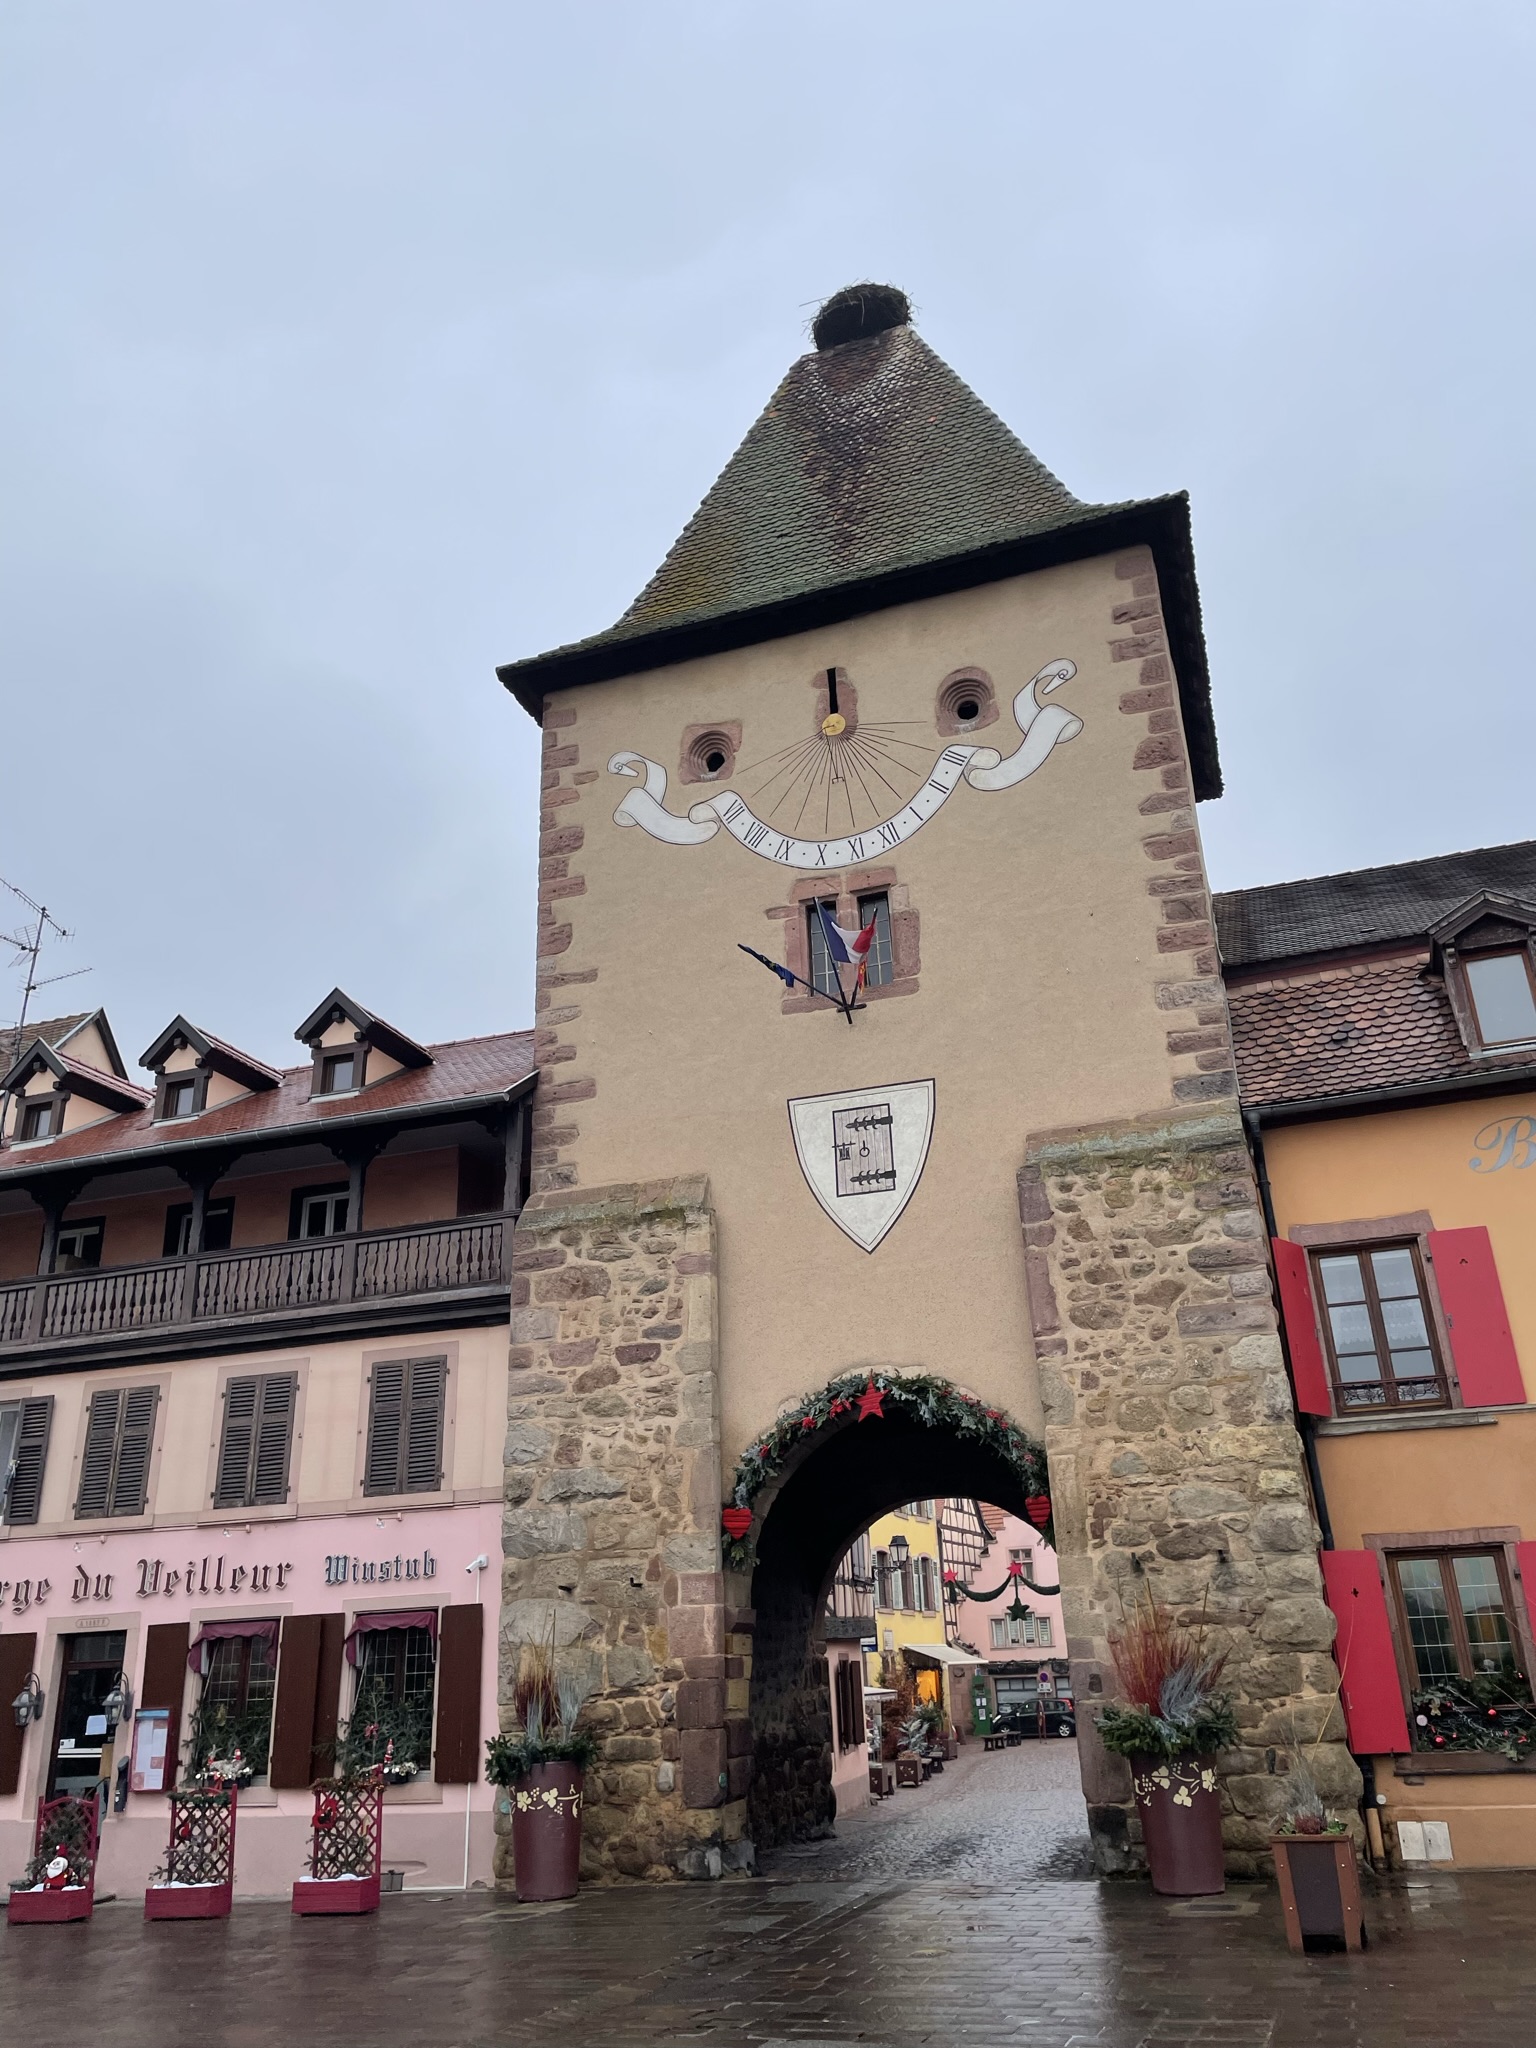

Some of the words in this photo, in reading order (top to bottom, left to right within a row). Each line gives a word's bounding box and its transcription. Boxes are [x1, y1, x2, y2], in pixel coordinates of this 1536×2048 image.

[773, 838, 795, 861] IX
[815, 843, 828, 866] X
[847, 836, 865, 861] XI
[876, 821, 901, 849] XII
[71, 1564, 114, 1602] du
[136, 1553, 294, 1598] Veilleur
[324, 1548, 437, 1585] Winstub
